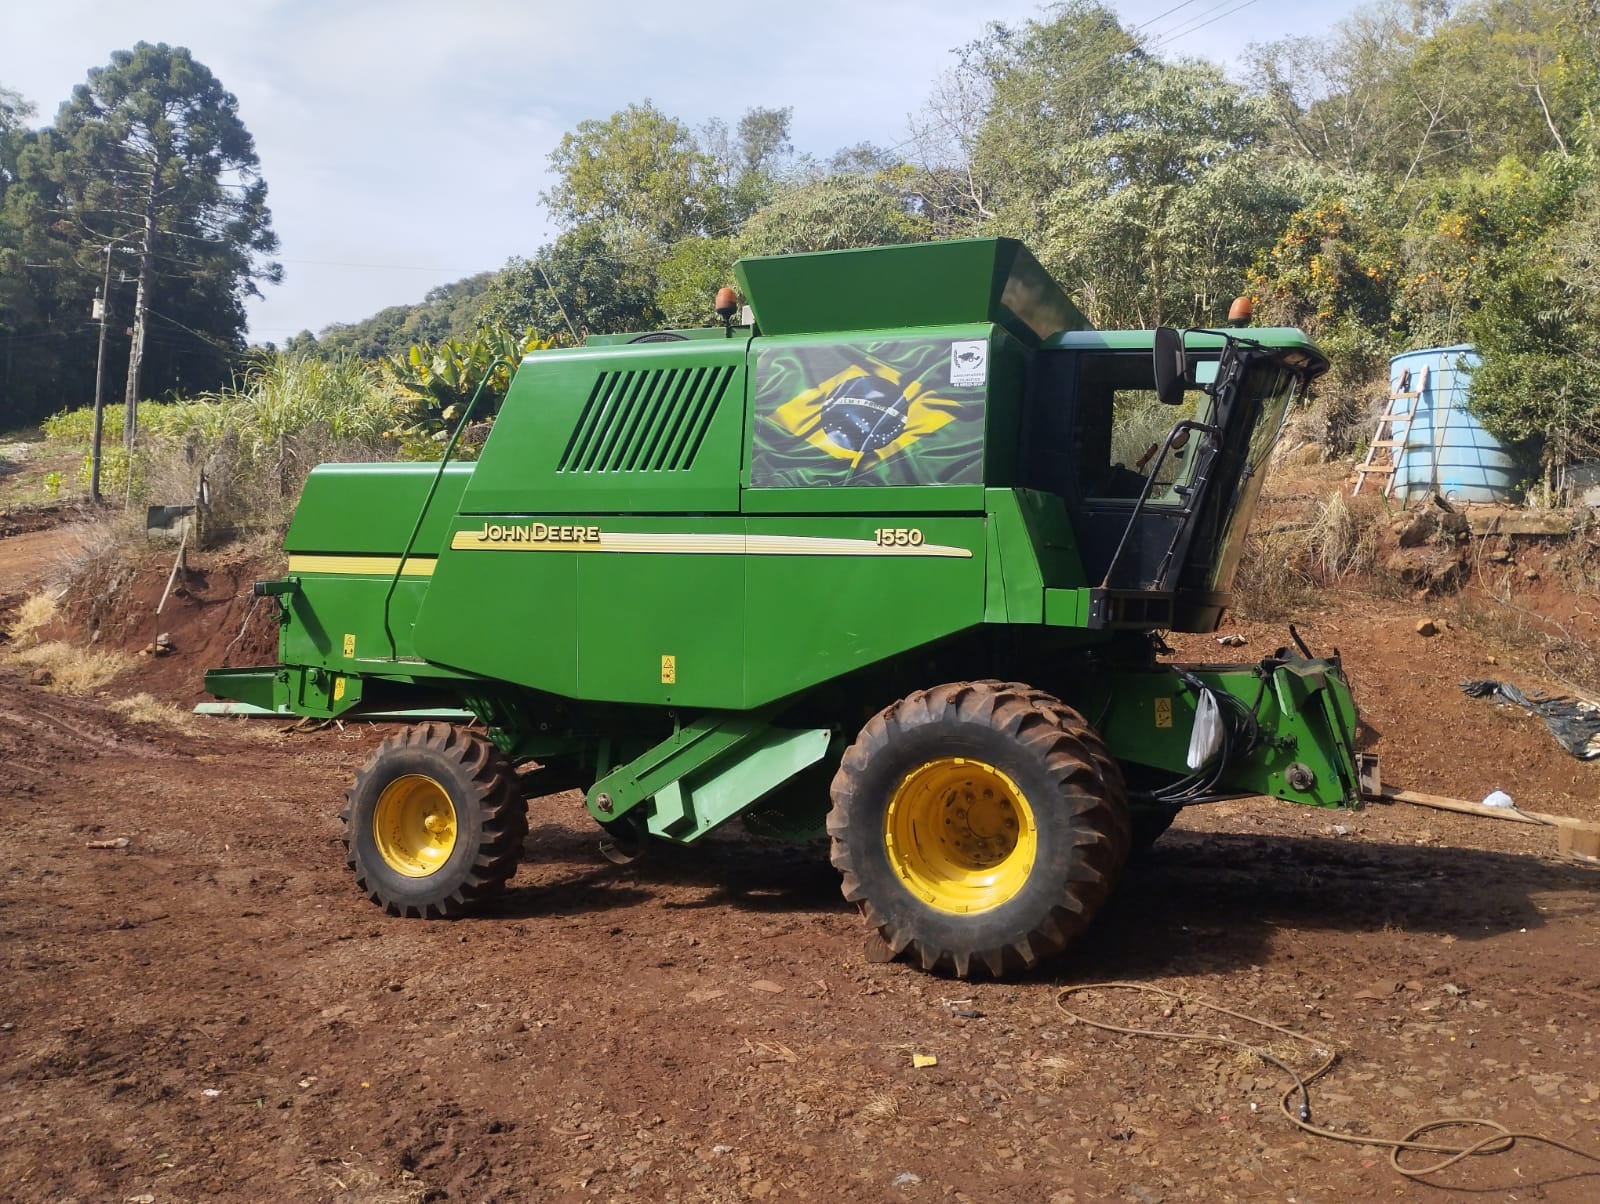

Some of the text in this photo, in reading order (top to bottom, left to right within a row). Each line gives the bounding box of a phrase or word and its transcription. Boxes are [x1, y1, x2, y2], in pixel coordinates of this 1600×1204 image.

[479, 522, 600, 543] JOHN DEERE
[874, 528, 923, 546] 1550
